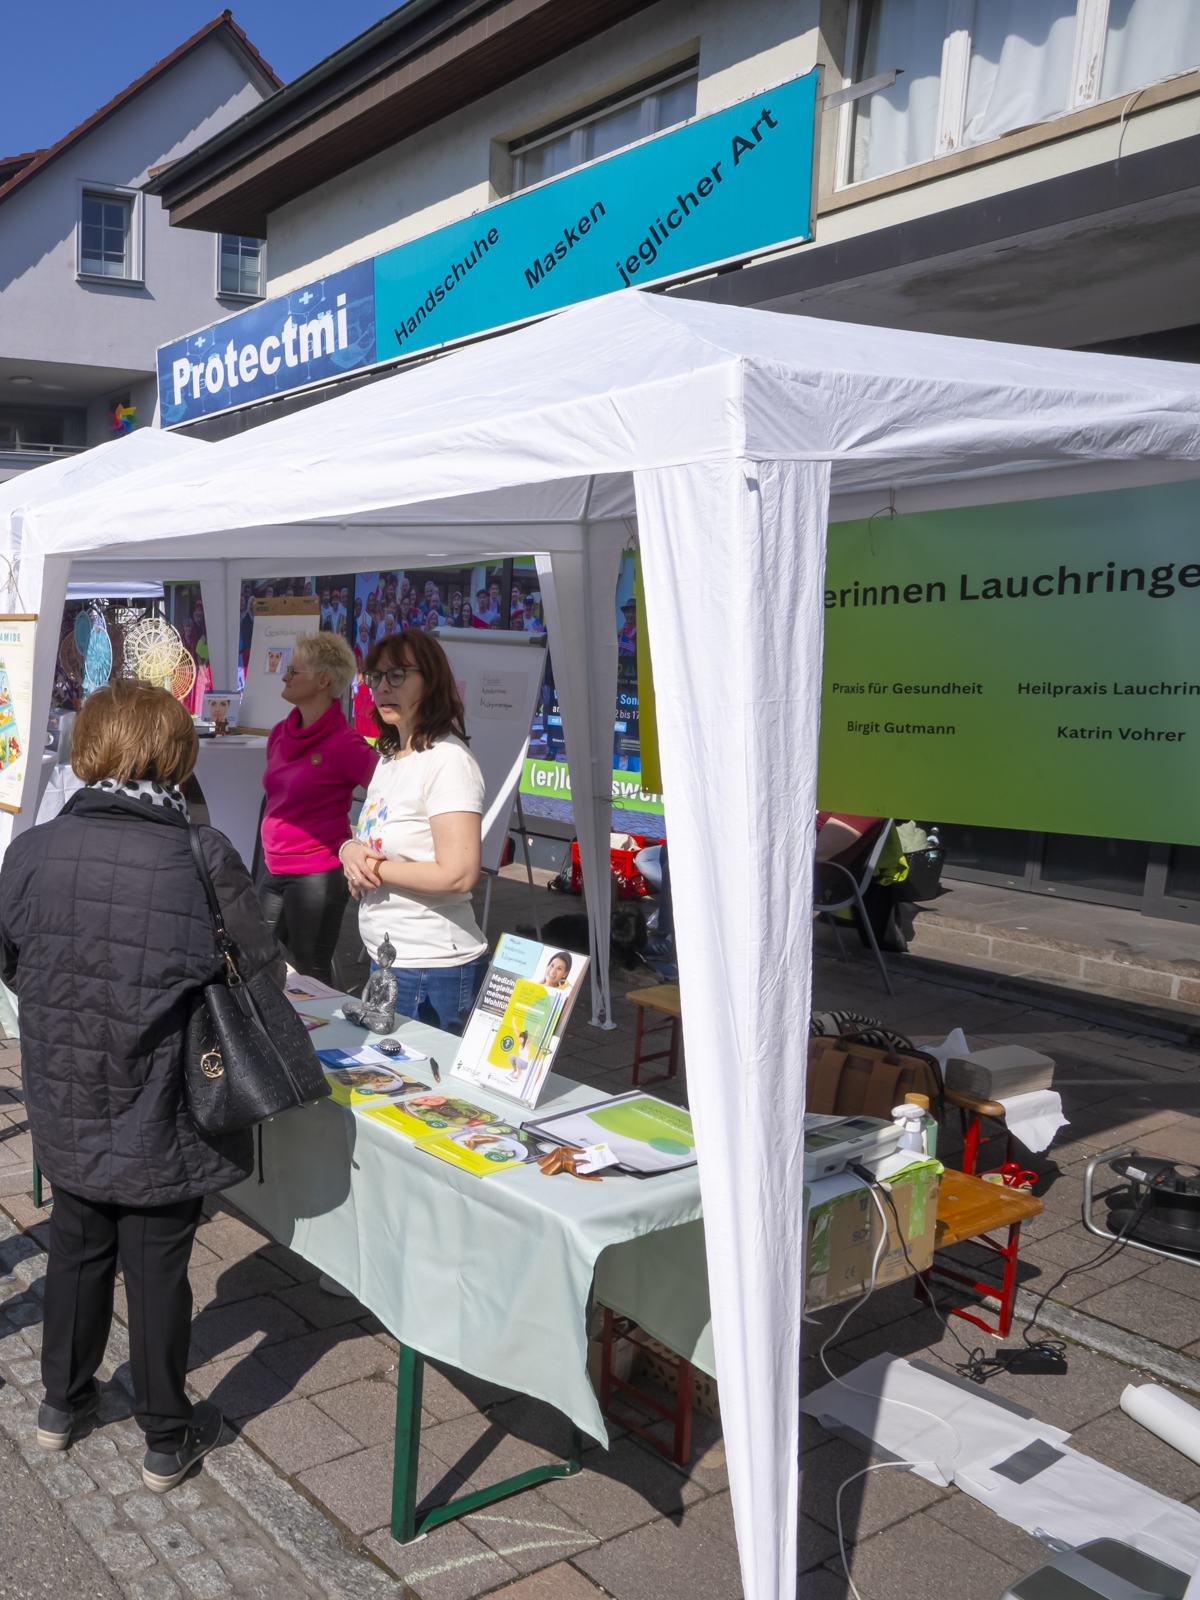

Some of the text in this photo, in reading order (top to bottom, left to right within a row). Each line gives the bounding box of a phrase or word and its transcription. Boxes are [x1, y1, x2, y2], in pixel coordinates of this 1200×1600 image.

[615, 106, 779, 288] jeglicher Art
[523, 199, 607, 291] Masken
[393, 225, 501, 346] Handschuhe
[172, 295, 349, 406] Protectmi
[823, 562, 1200, 609] erinnen Lauchringe
[832, 682, 983, 695] Praxis für Gesundheit
[1018, 682, 1200, 698] Heilpraxis Lauchrin
[620, 693, 639, 706] Son
[619, 709, 631, 719] bis
[847, 721, 956, 736] Birgit Gutmann
[1057, 726, 1186, 742] Katrin Vohrer
[491, 973, 516, 987] Medizin
[488, 981, 514, 995] begleite
[483, 995, 509, 1010] Wohlfüh
